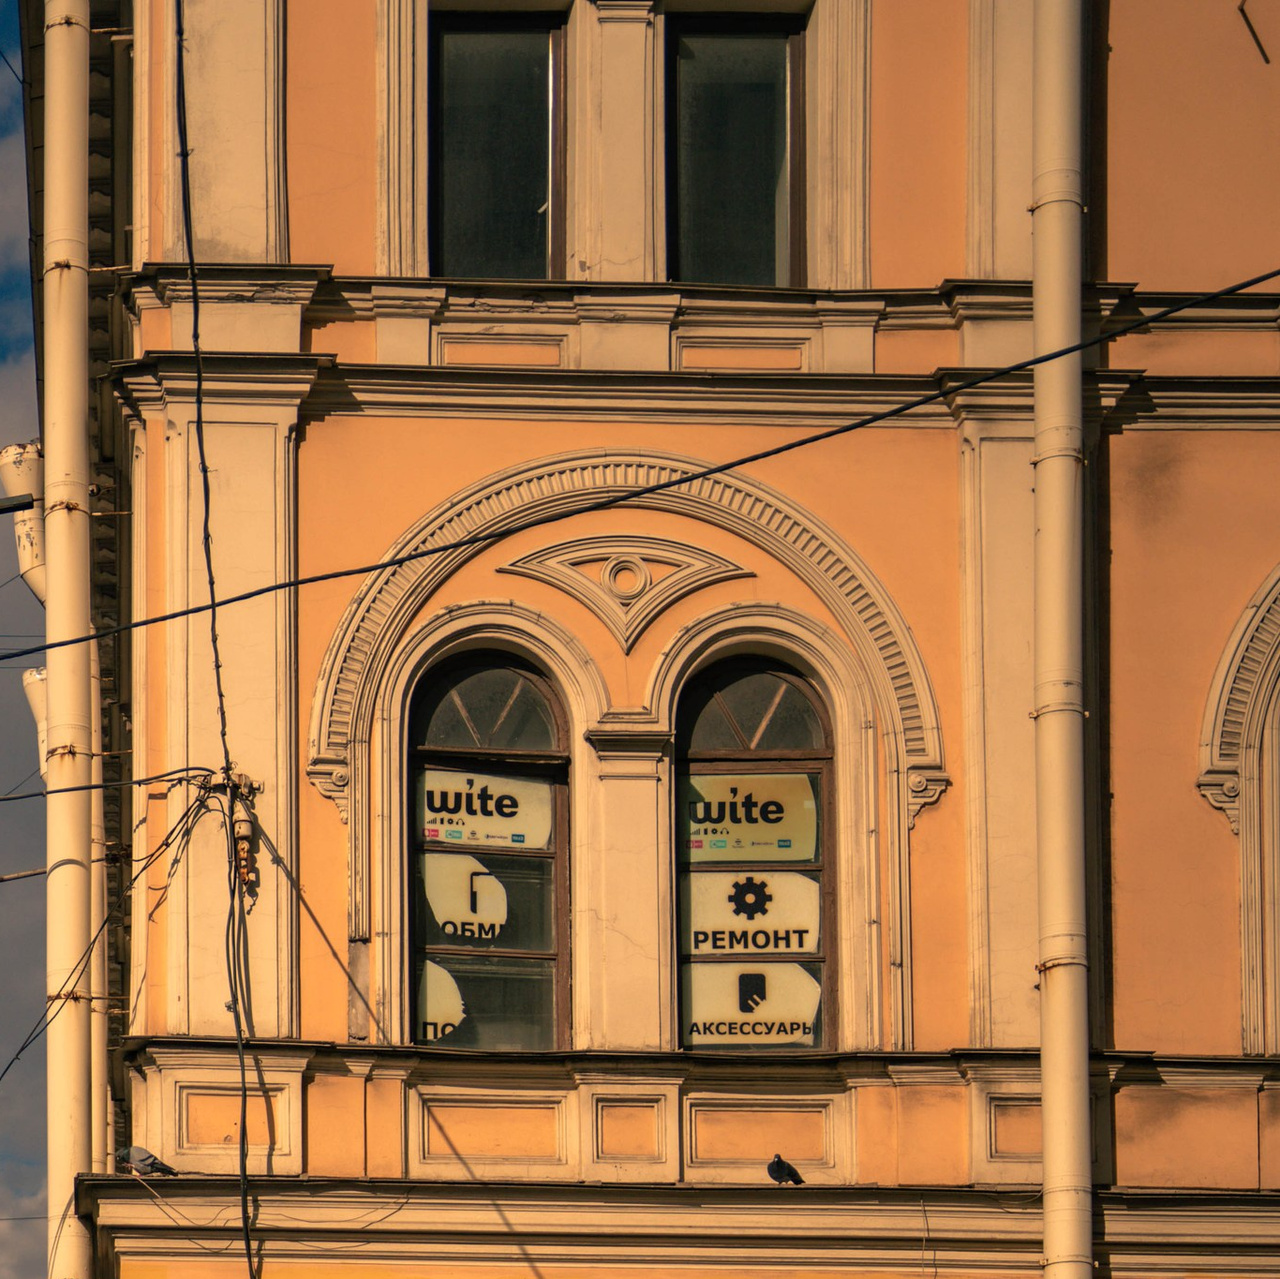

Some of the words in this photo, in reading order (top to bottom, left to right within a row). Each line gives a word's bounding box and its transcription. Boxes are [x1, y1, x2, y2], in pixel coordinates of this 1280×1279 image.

[426, 779, 518, 818] wite
[689, 787, 784, 824] wite
[441, 921, 505, 939] ОБМ
[693, 930, 809, 949] РЕМОНТ
